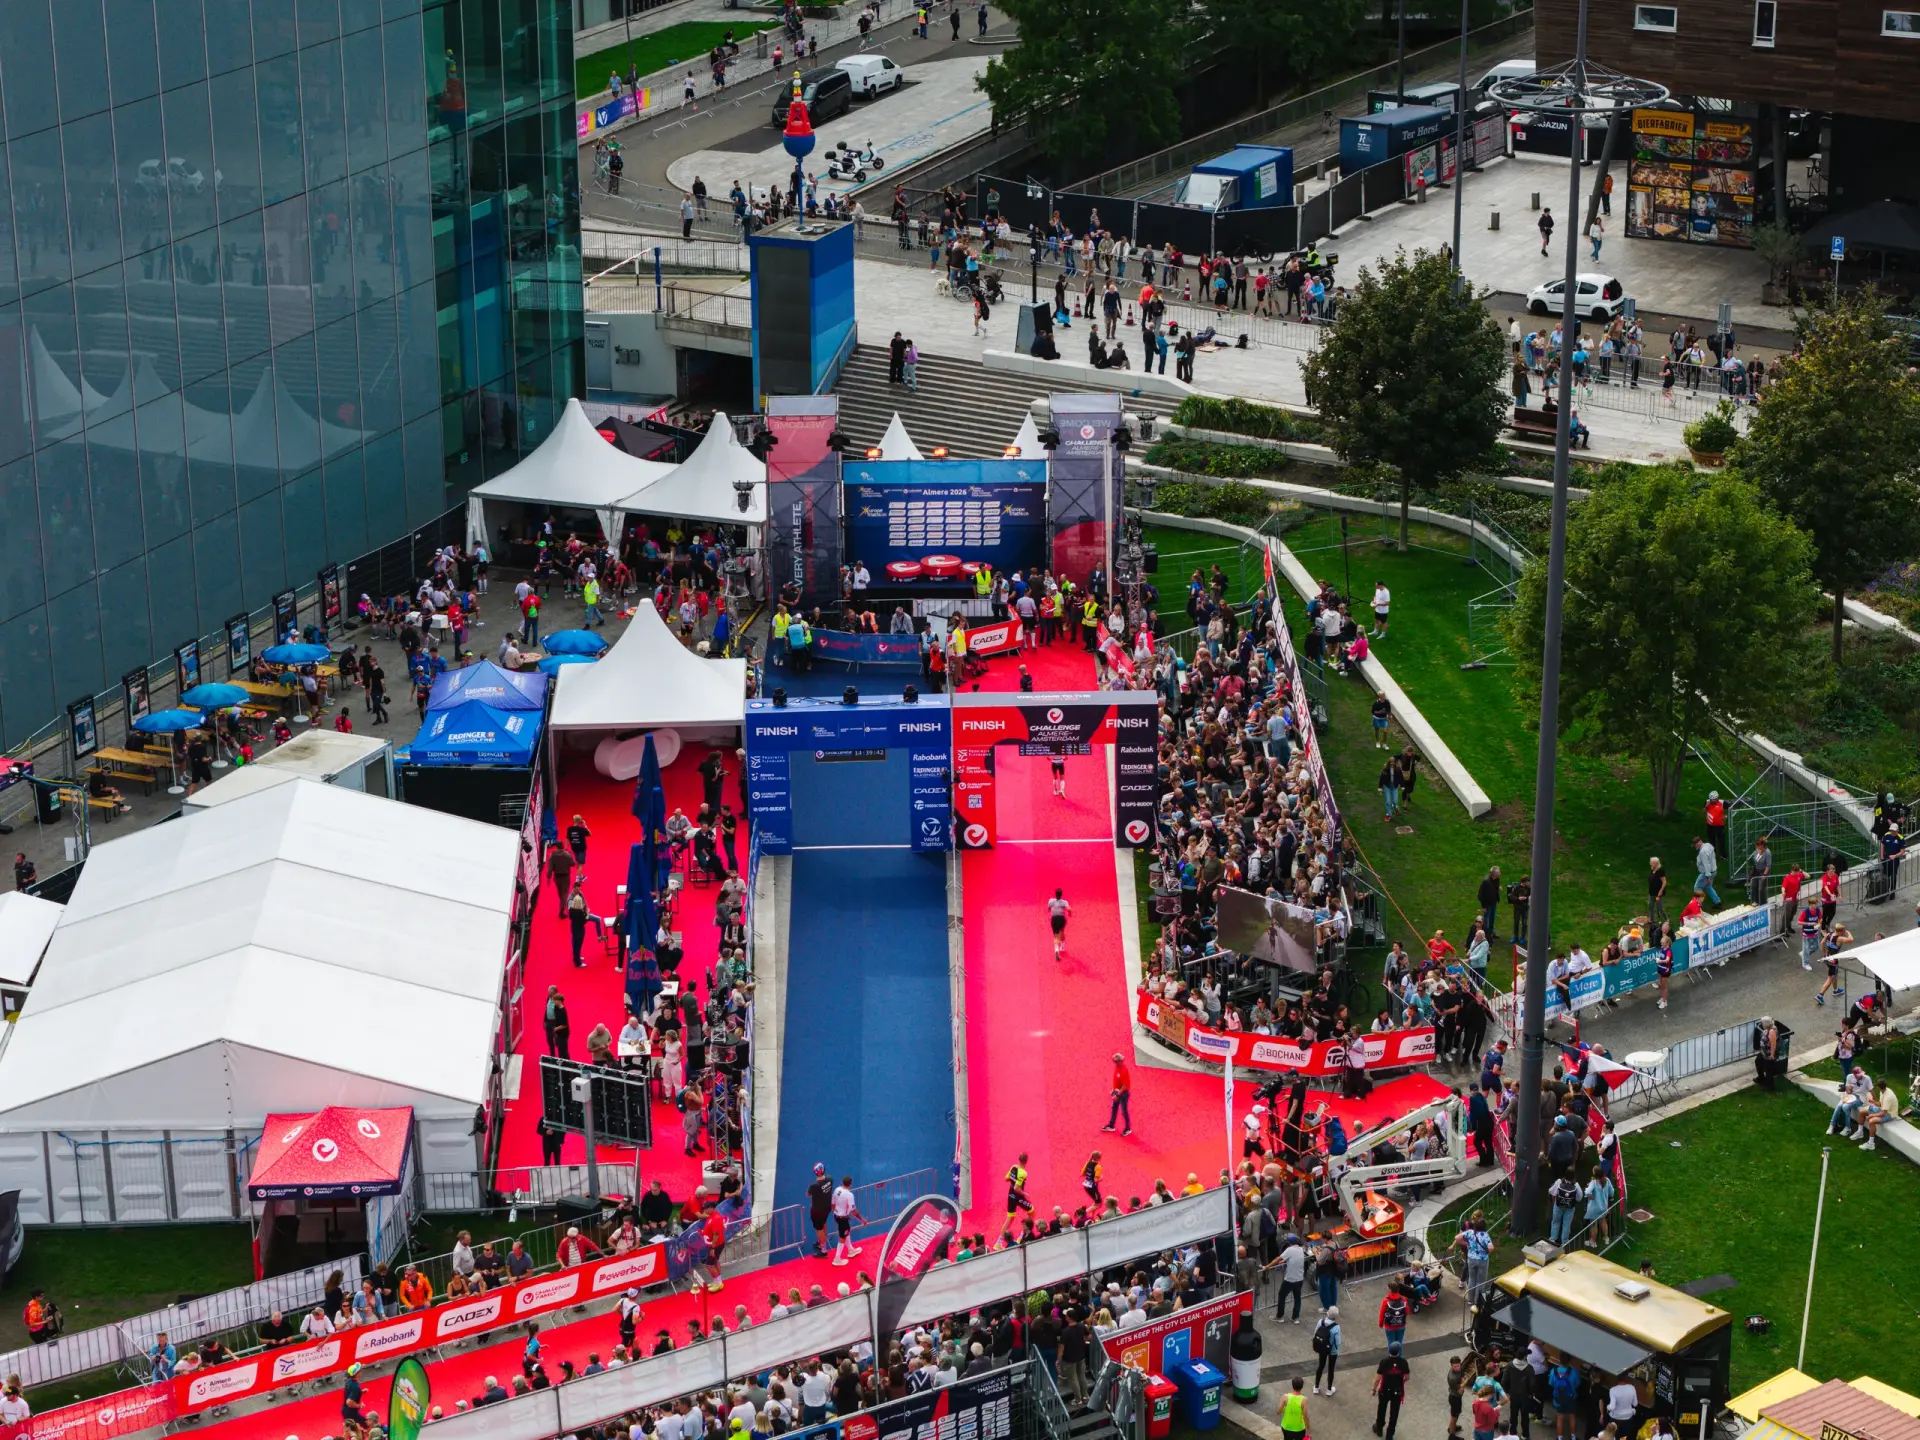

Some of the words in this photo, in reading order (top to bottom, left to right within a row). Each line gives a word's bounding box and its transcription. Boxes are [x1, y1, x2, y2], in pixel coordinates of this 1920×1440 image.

[1402, 130, 1415, 140] Ter
[1417, 124, 1439, 137] Horst
[1637, 119, 1689, 133] BIERFABRIEK
[950, 488, 967, 496] 2026
[792, 501, 803, 554] ATHLETE,
[973, 633, 1004, 646] CADEX
[464, 687, 497, 695] ERDINGER
[899, 722, 941, 733] FINISH
[962, 720, 1006, 731] FINISH
[1105, 718, 1149, 729] FINISH
[448, 731, 487, 741] ERDINGER
[755, 726, 798, 736] FINISH
[913, 753, 947, 761] Rabobank
[1632, 950, 1662, 969] BOCHAN
[1266, 1049, 1307, 1061] BOCHANE
[1387, 1165, 1412, 1174] snorkel
[894, 1214, 943, 1271] DESPERADOS
[598, 1262, 649, 1283] Powerbar
[534, 1282, 572, 1296] CHALLENGE
[535, 1291, 557, 1301] FAMILY
[444, 1305, 495, 1327] CADEX
[1116, 1336, 1133, 1347] LETS
[1133, 1330, 1150, 1341] KEEP
[1151, 1324, 1164, 1334] THE
[1164, 1319, 1179, 1330] CITY
[1179, 1313, 1202, 1326] CLEAN.
[1202, 1305, 1223, 1316] THANK
[370, 1328, 416, 1348] Rabobank
[209, 1377, 232, 1387] Almere
[209, 1386, 222, 1395] City
[222, 1378, 250, 1391] Marketing
[116, 1393, 169, 1413] CHALLENGE
[117, 1406, 150, 1420] FAMILY
[32, 1417, 86, 1438] CHALLENGE
